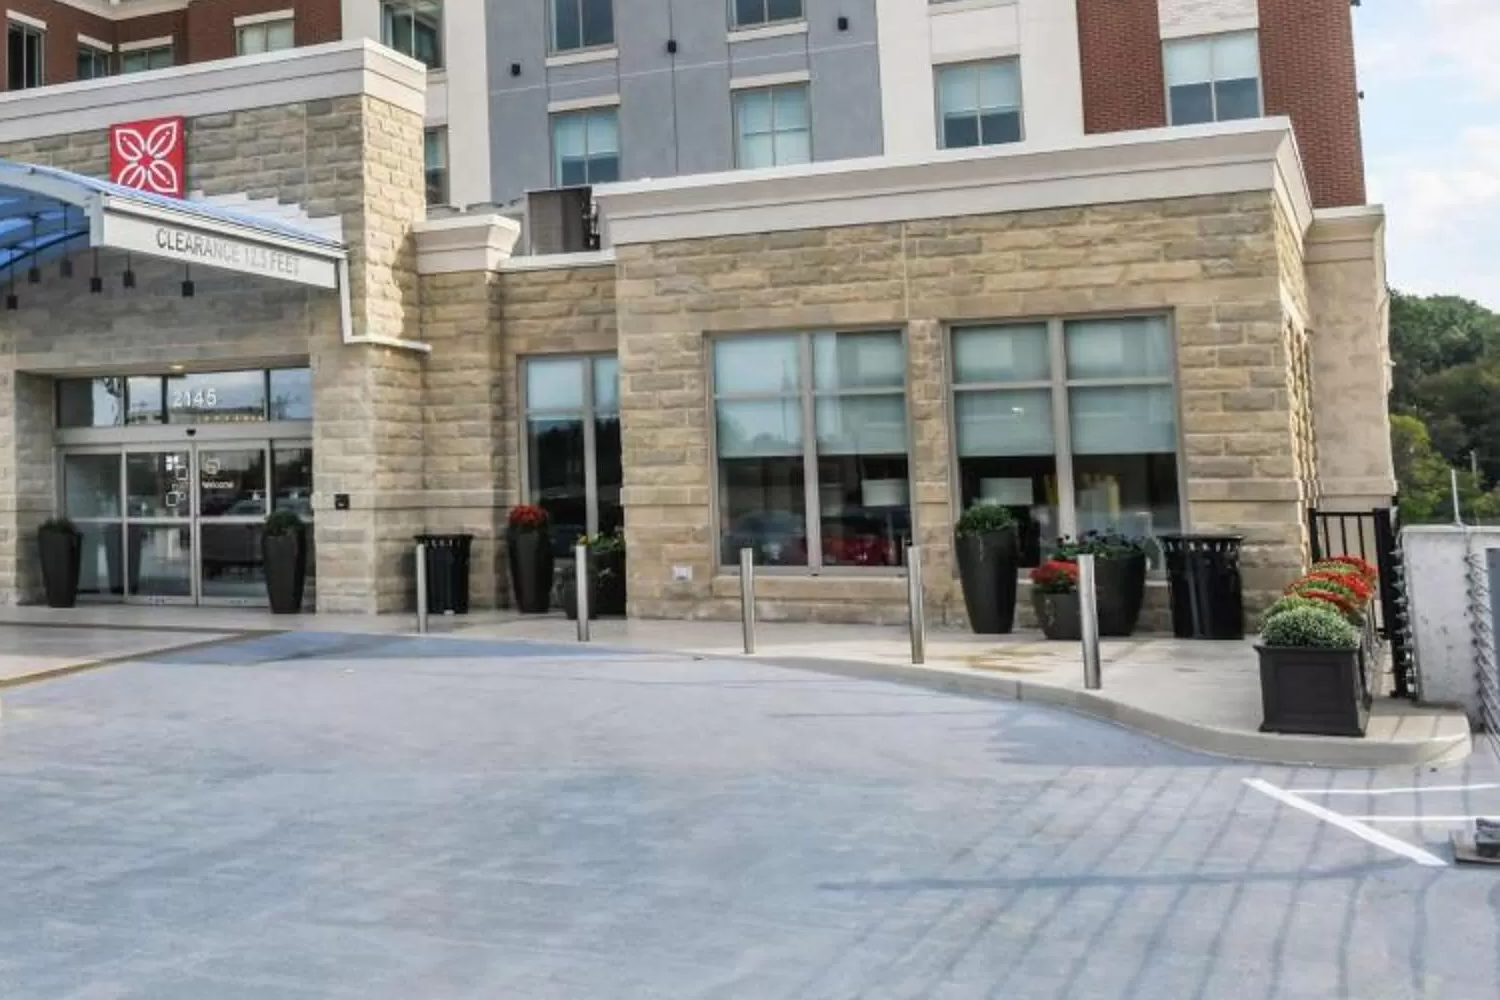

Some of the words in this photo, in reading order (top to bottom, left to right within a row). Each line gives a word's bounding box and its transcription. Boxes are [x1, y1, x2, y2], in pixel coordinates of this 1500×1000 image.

[156, 227, 241, 263] CLEARANCE
[270, 250, 300, 277] FEET
[171, 388, 217, 408] 2145
